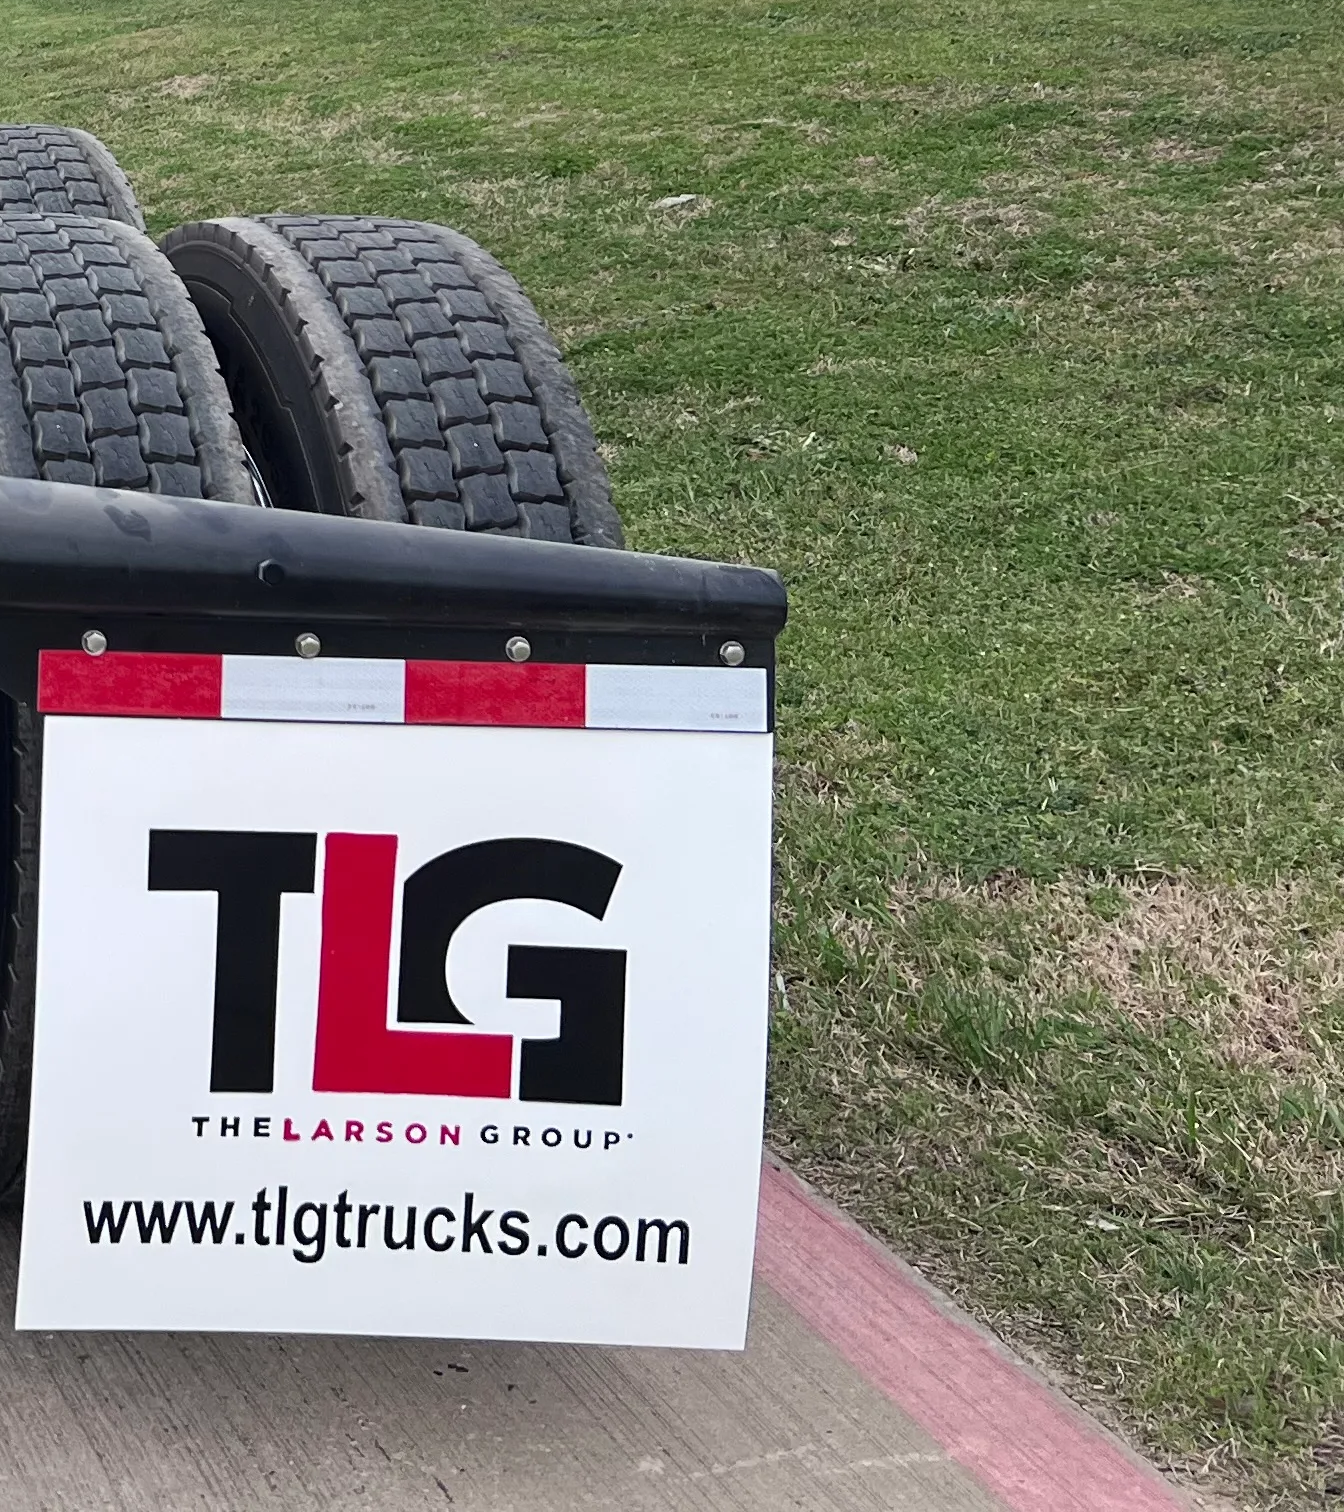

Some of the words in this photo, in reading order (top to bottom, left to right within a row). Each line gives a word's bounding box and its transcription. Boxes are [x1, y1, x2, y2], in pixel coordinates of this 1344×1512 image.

[148, 829, 628, 1106] TLG
[480, 1124, 621, 1150] GROUP
[83, 1185, 691, 1265] www.tlgtrucks.com
